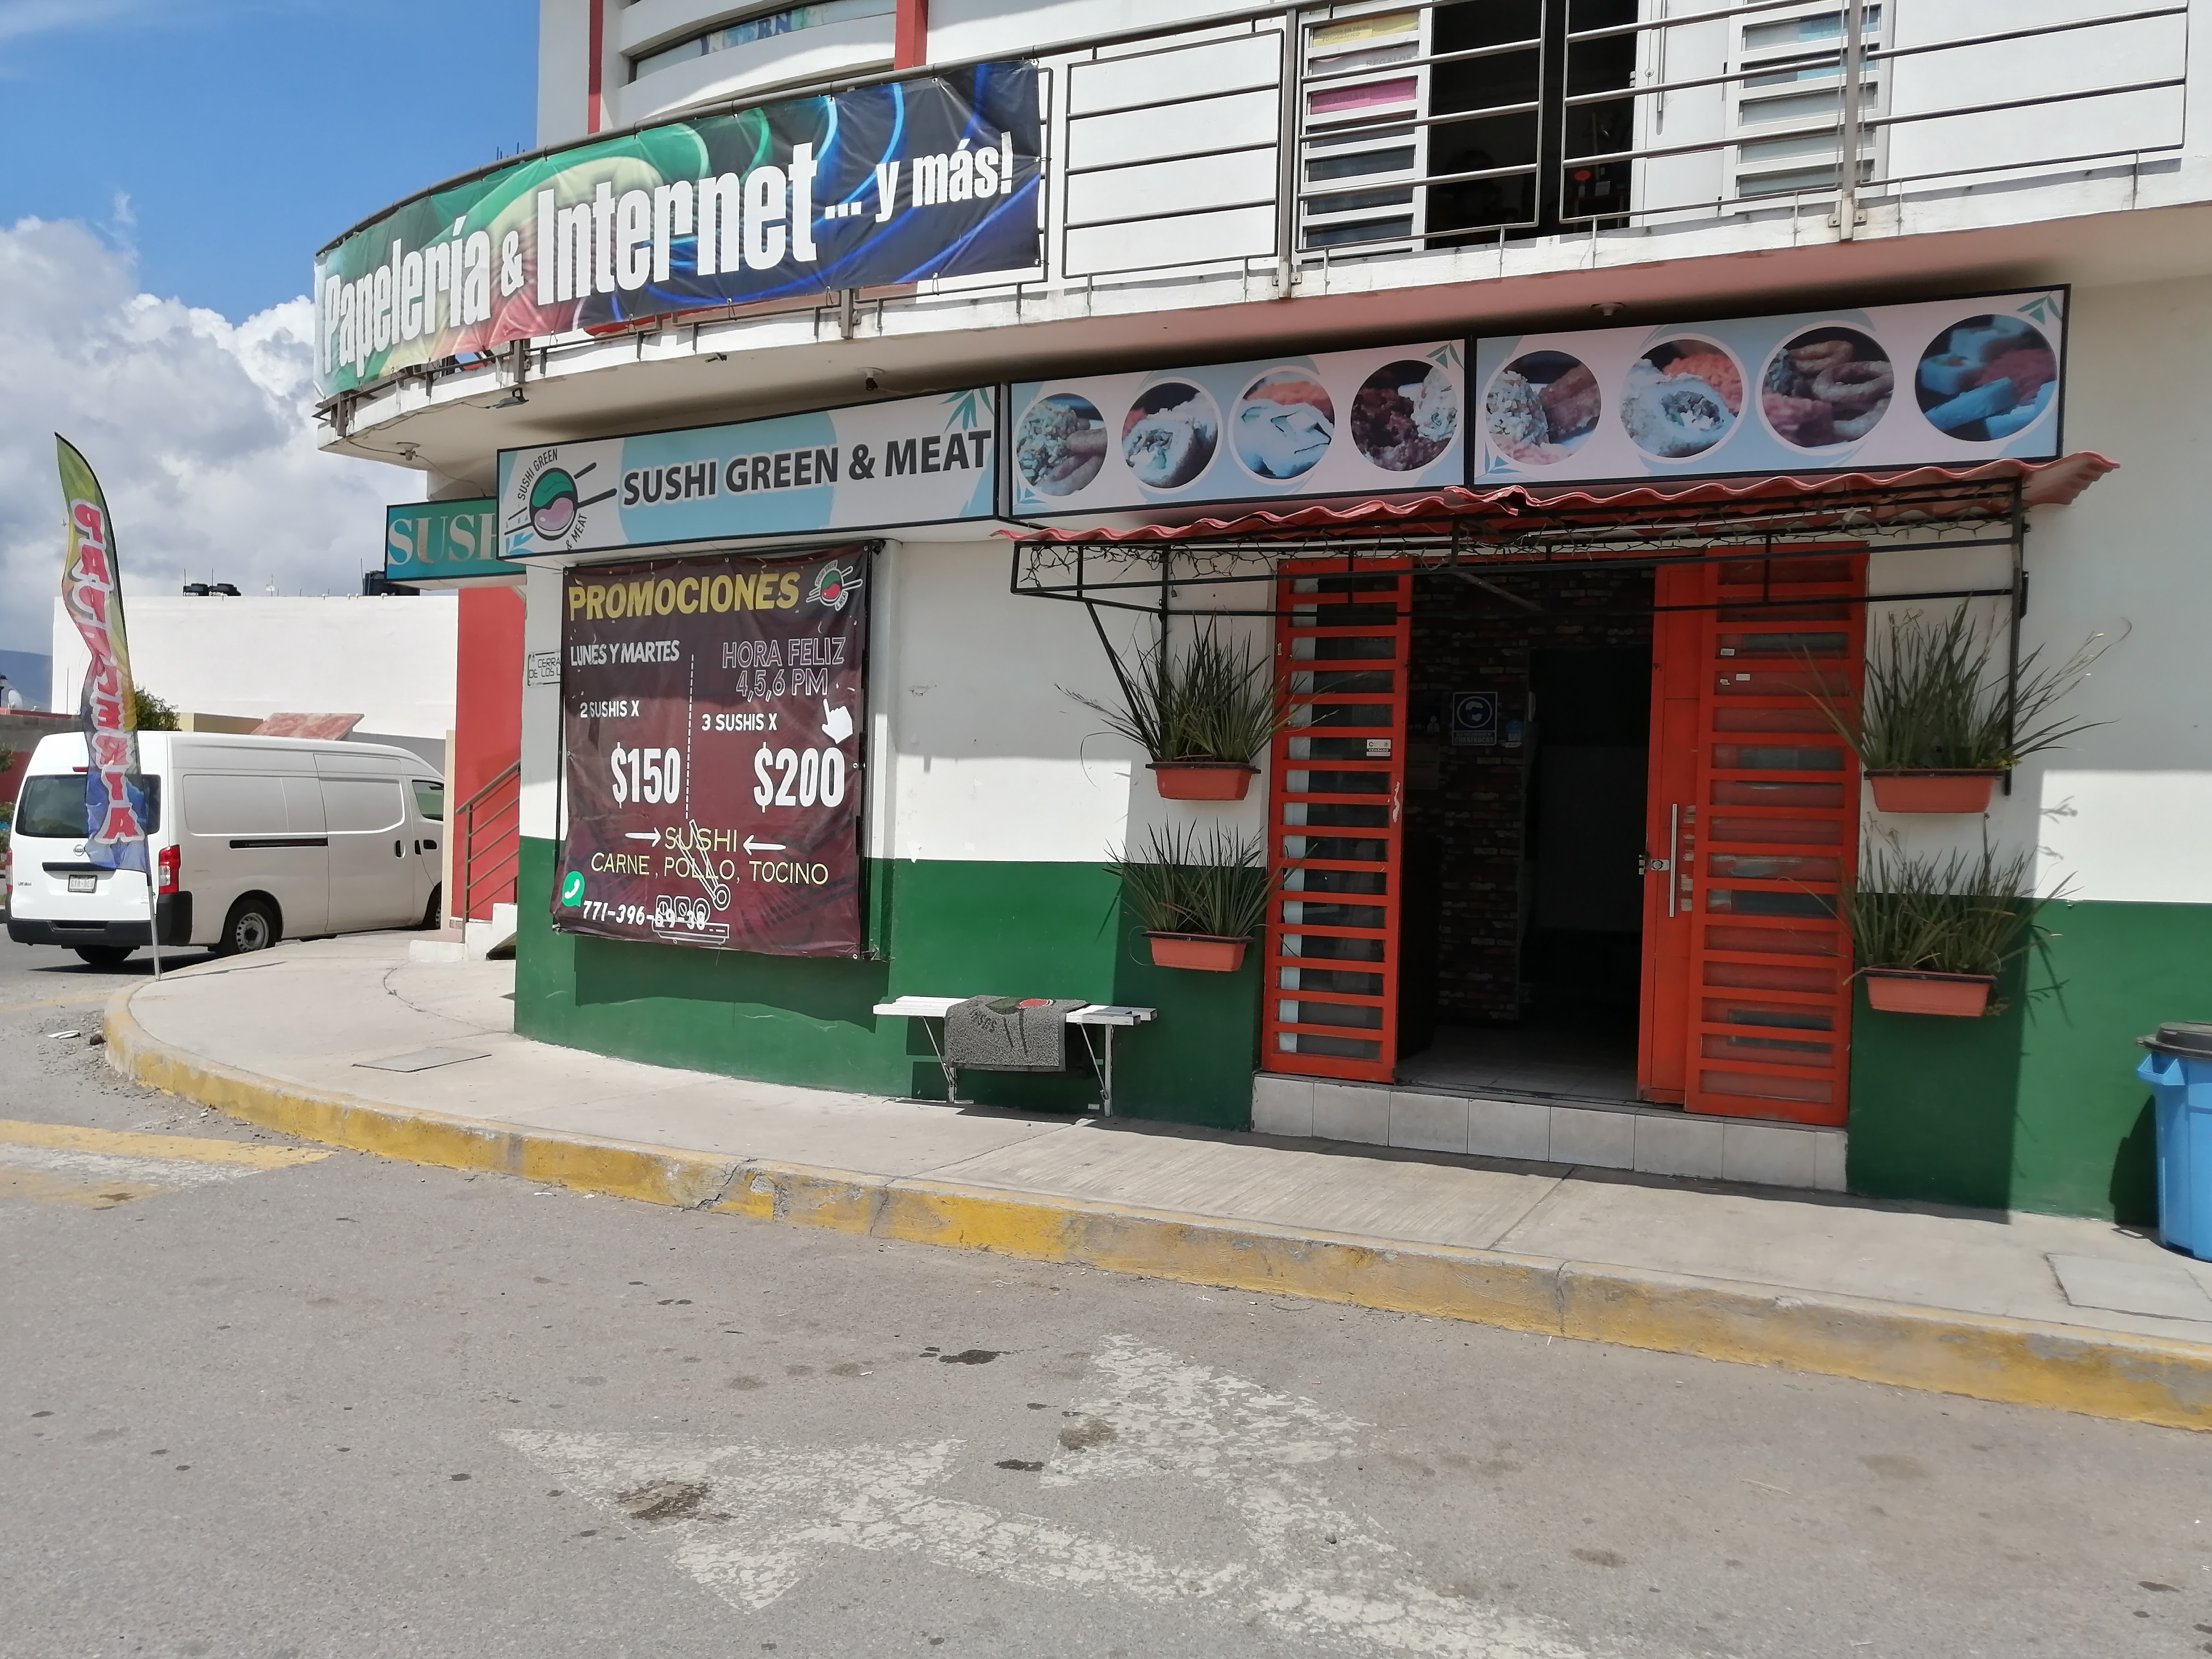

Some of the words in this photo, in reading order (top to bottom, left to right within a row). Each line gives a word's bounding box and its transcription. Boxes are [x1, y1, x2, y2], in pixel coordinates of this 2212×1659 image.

[324, 215, 491, 377] Papelería
[501, 231, 524, 297] &
[538, 142, 818, 306] Internet
[875, 161, 900, 223] y
[912, 131, 1014, 207] más!
[518, 468, 535, 501] SUSHI
[533, 448, 558, 472] GREEN
[624, 461, 717, 506] SUSHI
[726, 447, 838, 493] GREEN
[848, 443, 876, 480] &
[885, 429, 991, 477] MEAT
[571, 513, 588, 542] MEAT
[569, 572, 801, 621] PROMOCIONES
[570, 643, 607, 667] LUNES
[609, 643, 620, 665] Y
[620, 640, 680, 664] MARTES
[722, 640, 782, 669] HORA
[788, 637, 846, 666] FELIZ
[529, 669, 538, 678] DE
[541, 667, 554, 677] LOS
[791, 668, 828, 696] PM
[580, 702, 588, 718] 2
[590, 700, 628, 718] SUSHIS
[631, 700, 640, 717] X
[701, 715, 711, 731] 3
[715, 713, 764, 732] SUSHIS
[768, 713, 777, 731] X
[611, 742, 681, 808] $150
[753, 741, 845, 812] $200
[665, 827, 737, 853] SUSHI
[749, 860, 829, 885] TOCINO
